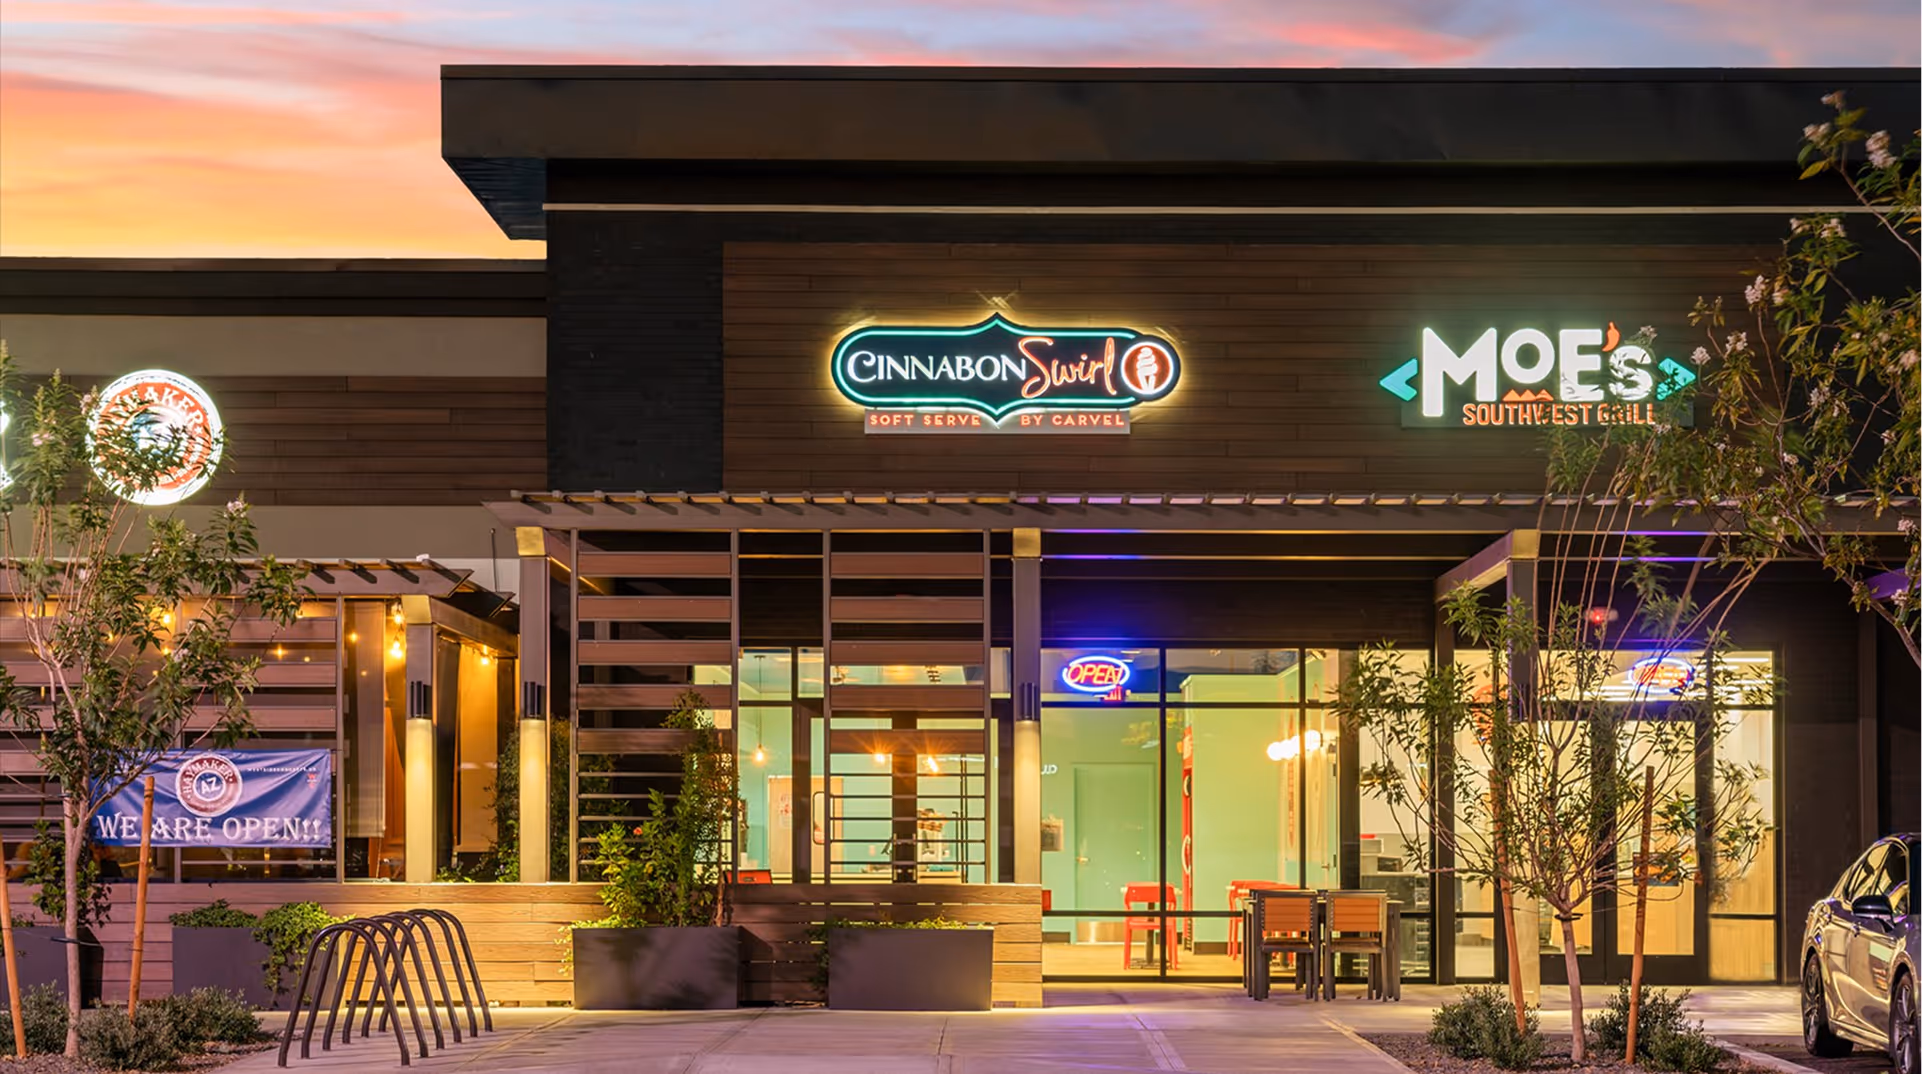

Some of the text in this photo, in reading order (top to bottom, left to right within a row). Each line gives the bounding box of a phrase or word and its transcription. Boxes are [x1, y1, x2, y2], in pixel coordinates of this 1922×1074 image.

[847, 336, 1117, 399] CINNABON Swirl
[869, 414, 1125, 427] SOFT SERVE BY CARVEL
[1462, 403, 1592, 426] SOUTHWEST
[1068, 664, 1124, 685] OPEN
[182, 759, 235, 794] HAYMAKER
[201, 776, 221, 795] AZ
[97, 811, 322, 841] WE ARE OPEN!!
